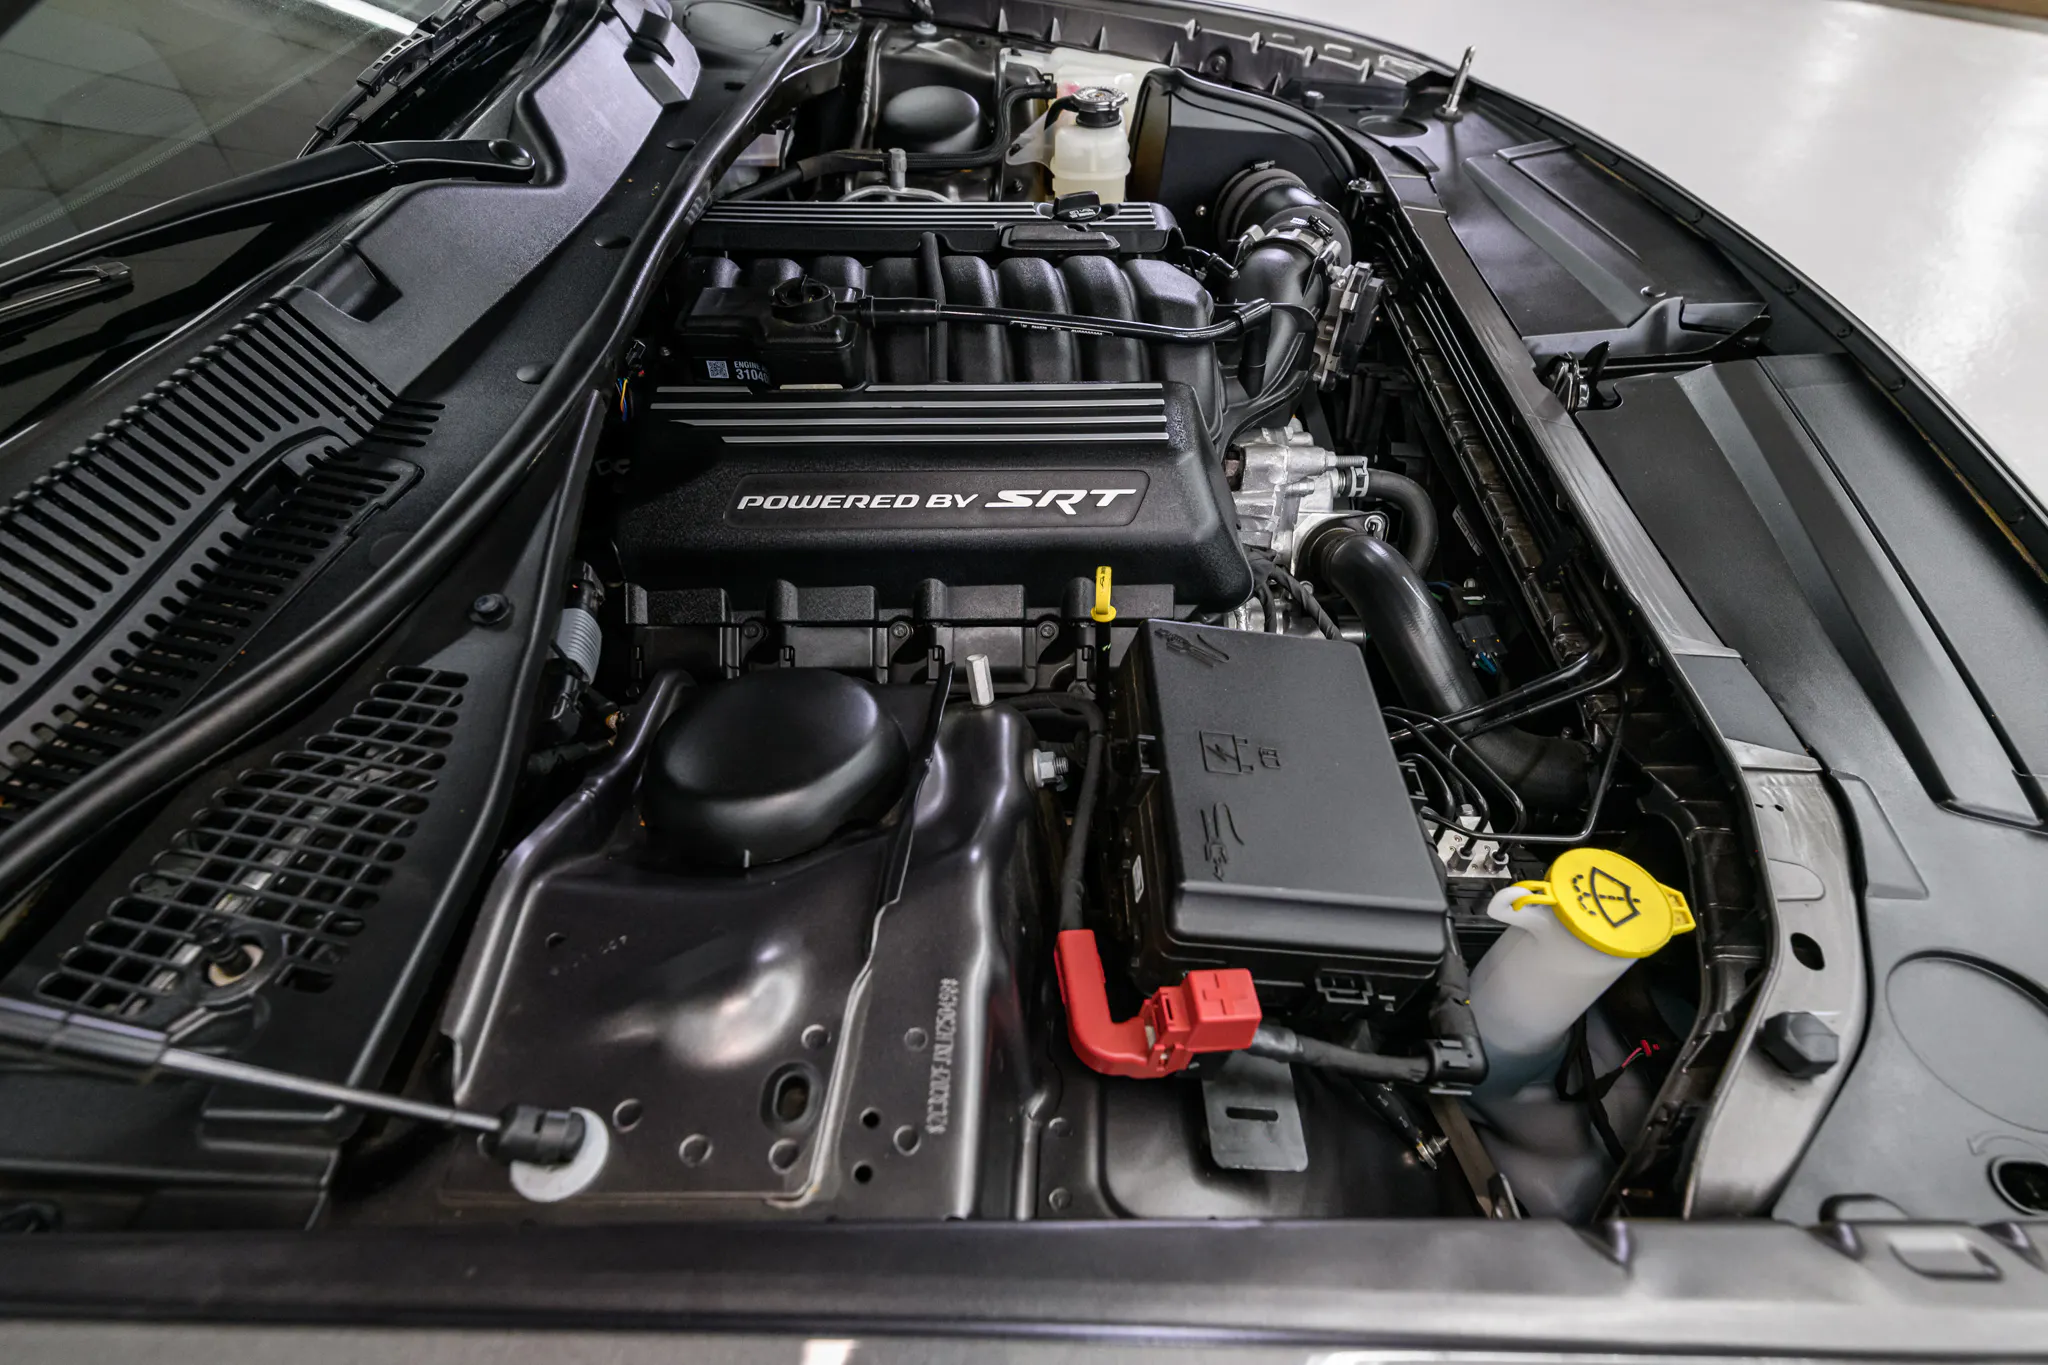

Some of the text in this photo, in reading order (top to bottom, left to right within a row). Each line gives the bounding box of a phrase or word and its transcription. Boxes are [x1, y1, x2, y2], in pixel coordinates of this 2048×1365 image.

[733, 360, 761, 371] ENGINE
[737, 488, 1137, 516] POWERED BY SRT
